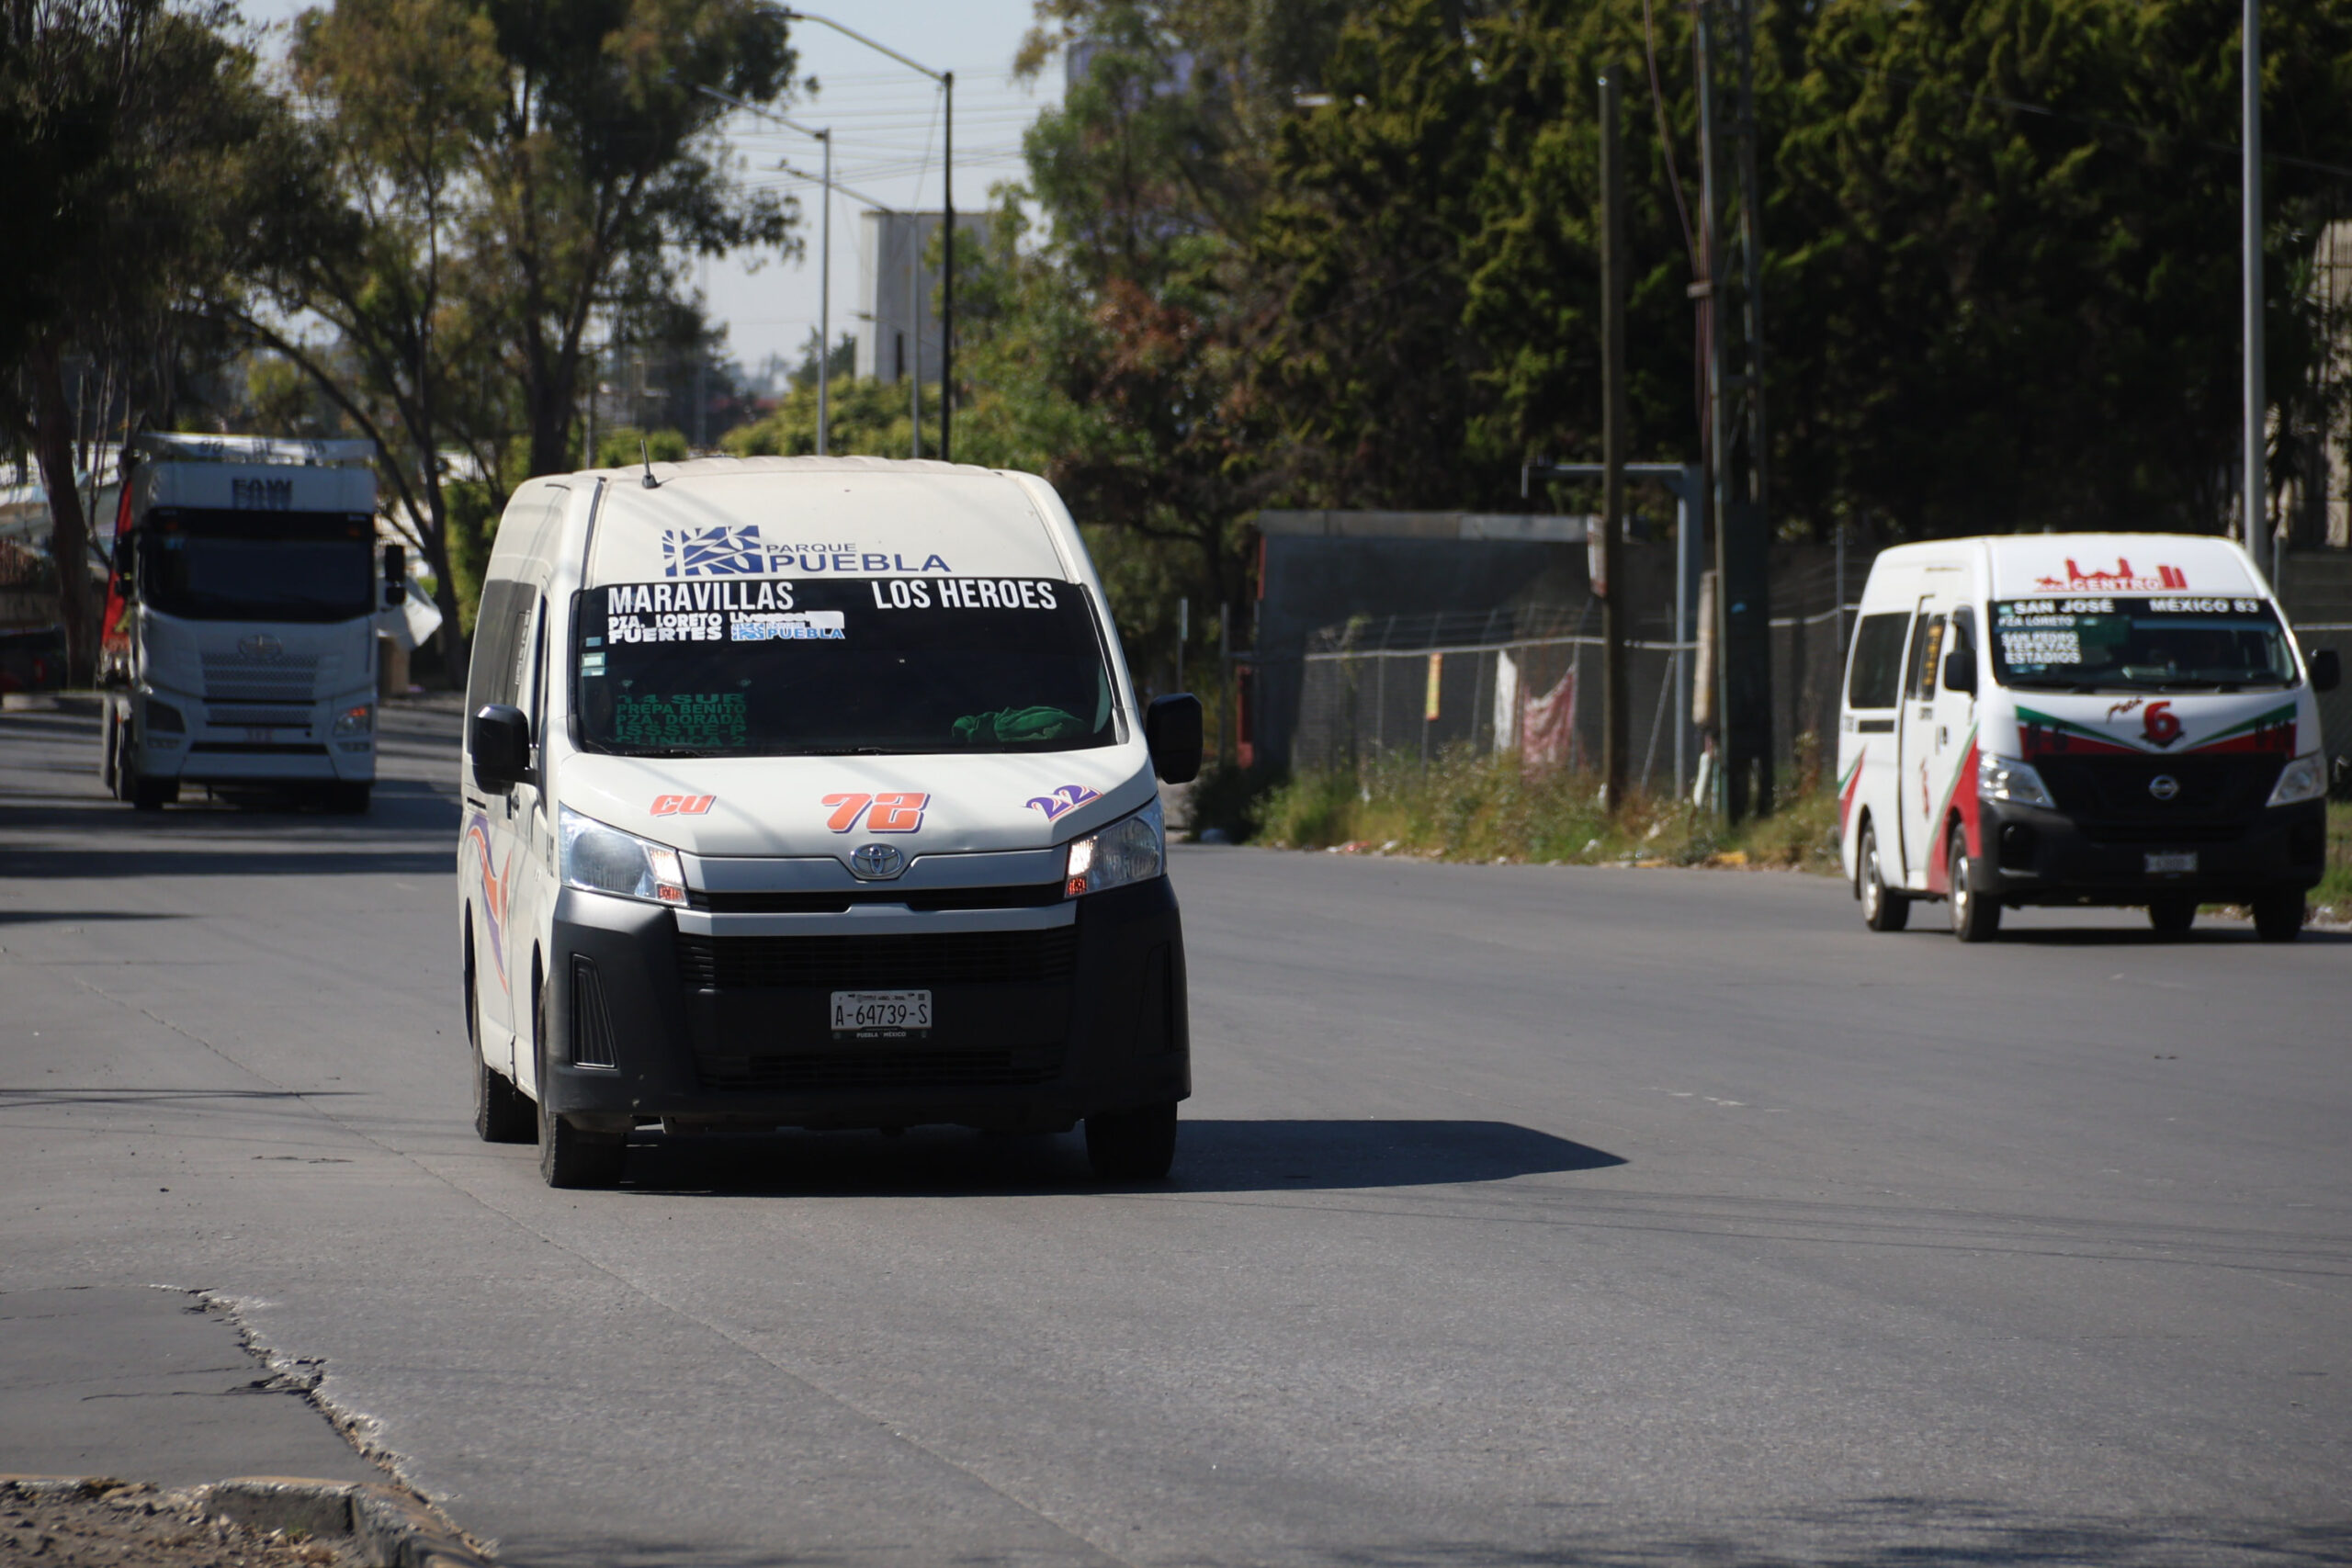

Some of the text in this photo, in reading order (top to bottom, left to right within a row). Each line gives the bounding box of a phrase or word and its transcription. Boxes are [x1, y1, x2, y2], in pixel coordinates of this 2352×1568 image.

[766, 543, 857, 553] PARQUE
[770, 553, 952, 572] PUEBLA
[2072, 578, 2159, 591] CENTRO
[608, 581, 794, 615] MARAVILLAS
[872, 579, 1057, 610] LOS HEROES
[2014, 600, 2055, 615] SAN
[608, 613, 722, 628] PZA. LORETO
[608, 626, 722, 643] FUERTES
[766, 627, 845, 639] PUEBLA
[2005, 652, 2081, 664] ESTADIOS
[672, 694, 746, 704] SUR
[617, 704, 747, 715] PREPA BENITO
[666, 715, 746, 725] DORADA
[2143, 701, 2180, 741] 6
[1021, 784, 1104, 822] 22
[820, 792, 931, 834] 72
[835, 1003, 928, 1026] A-64739-S
